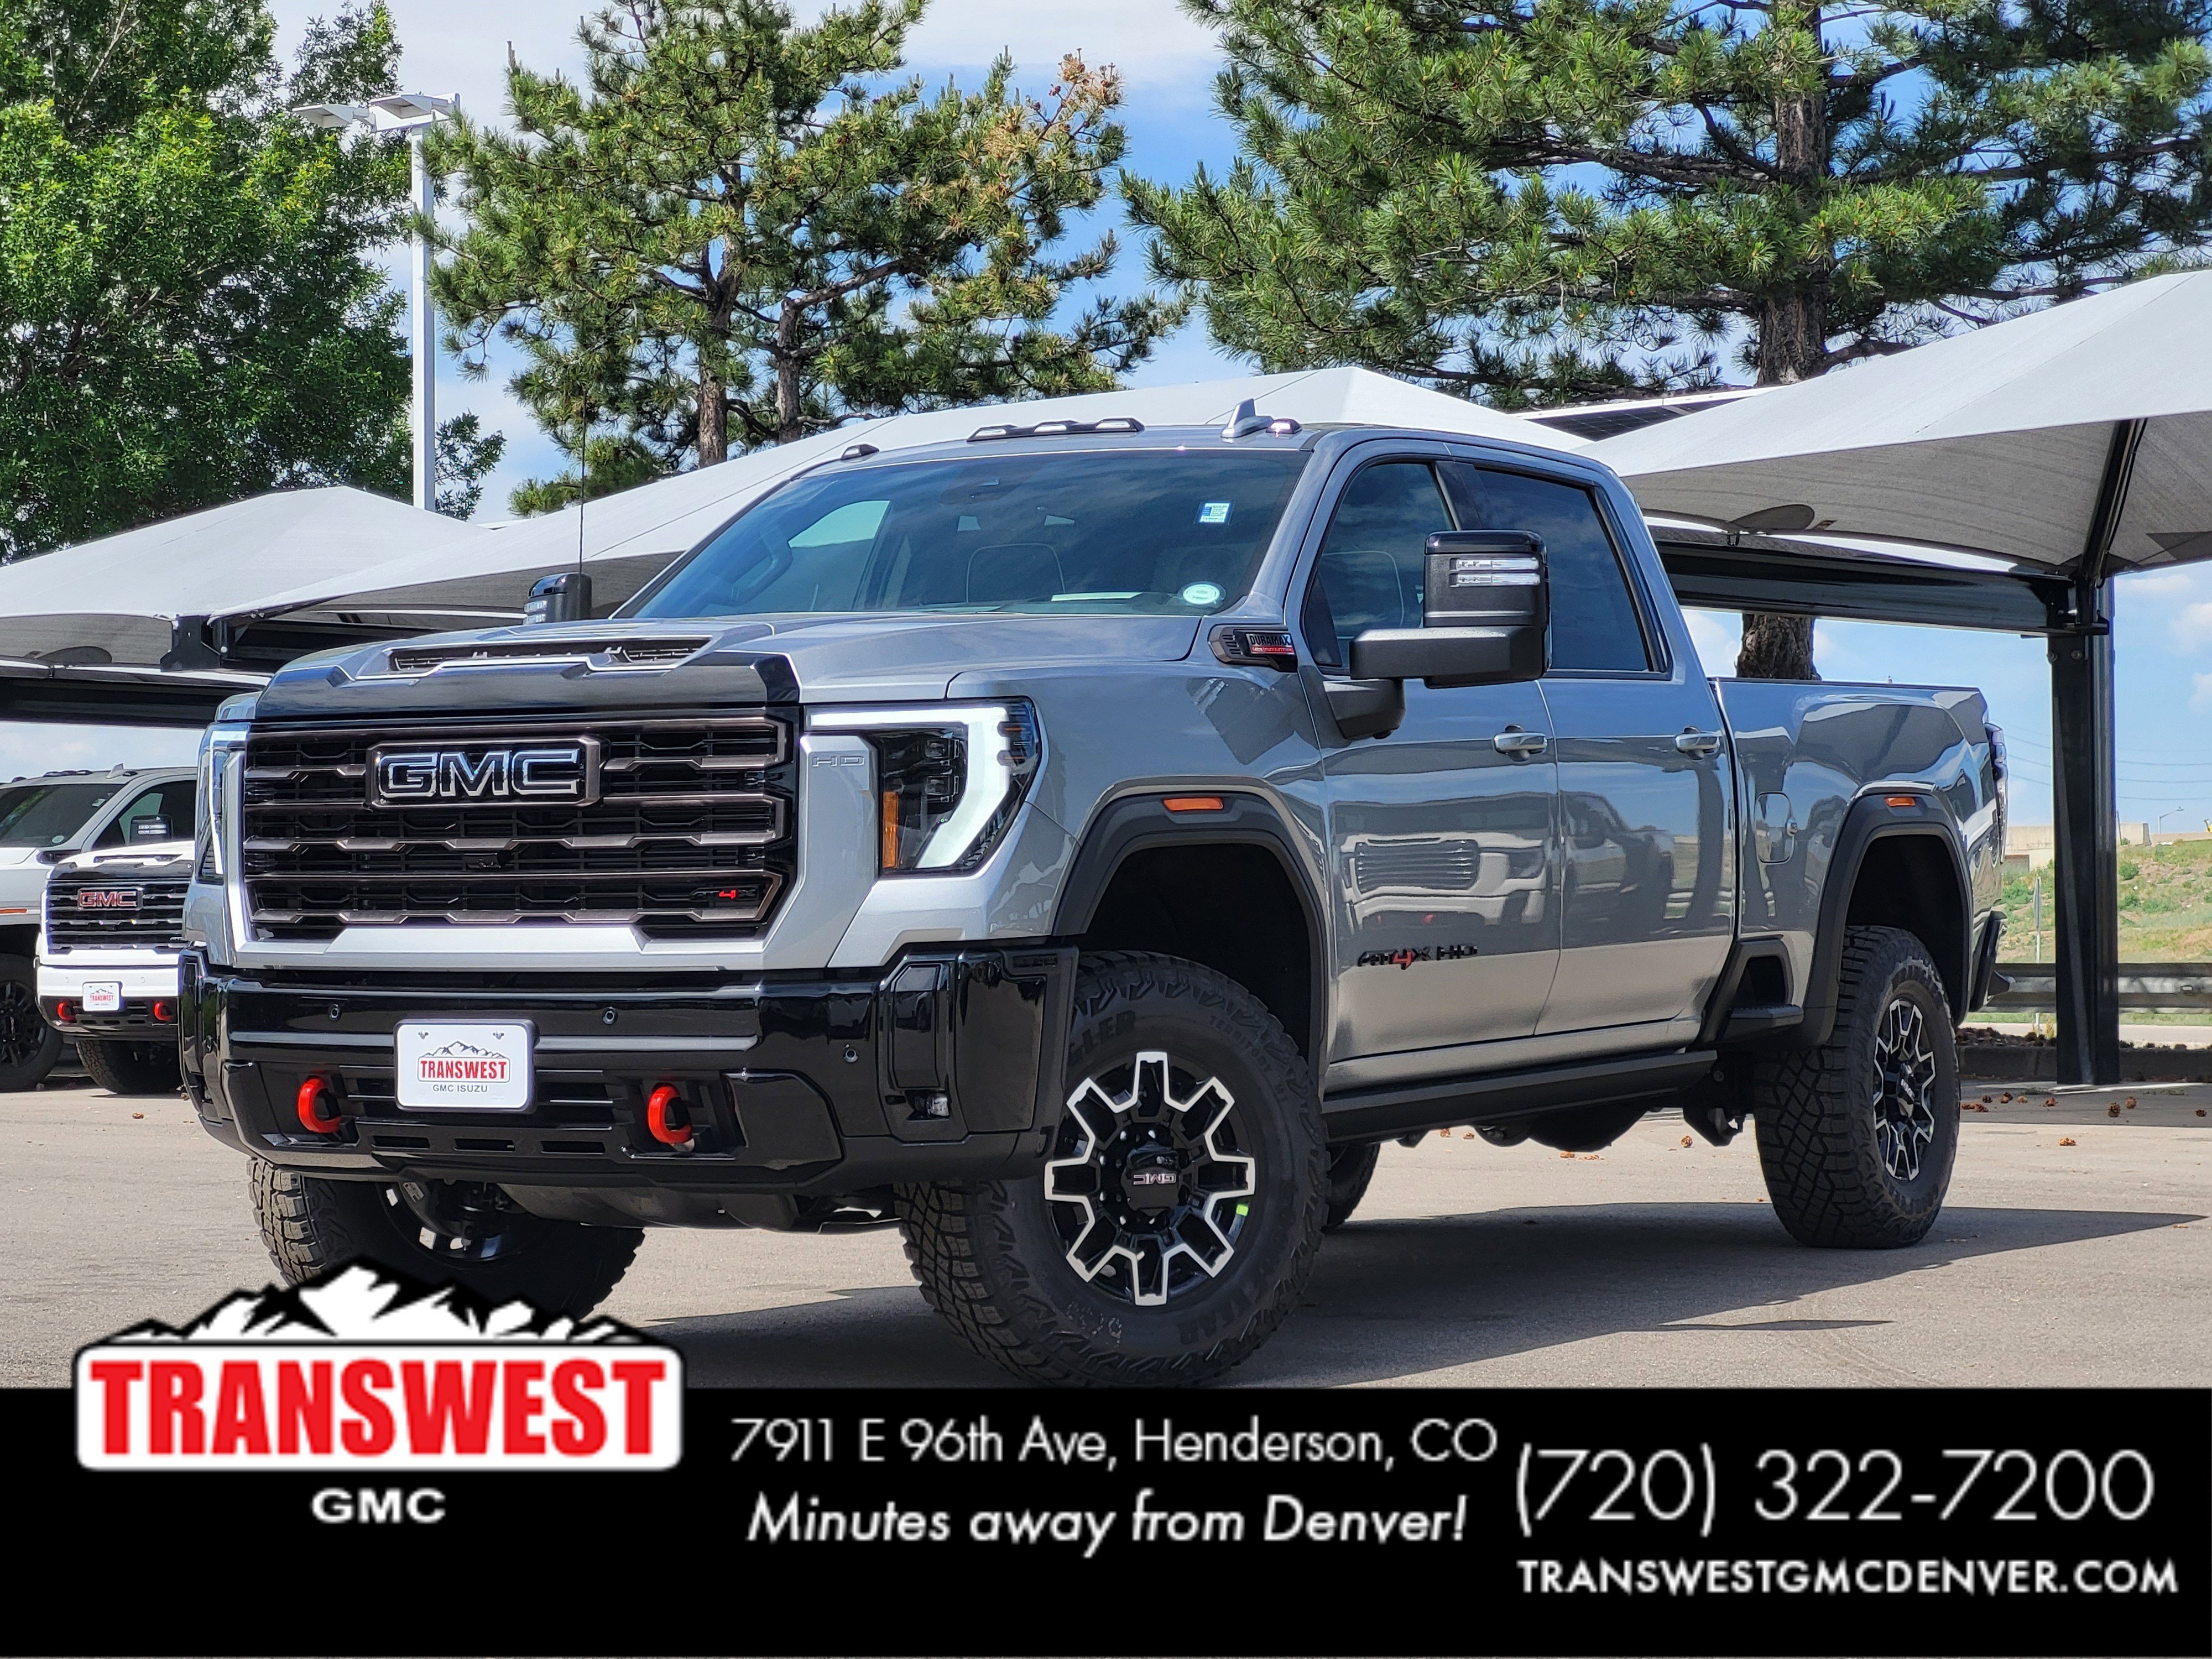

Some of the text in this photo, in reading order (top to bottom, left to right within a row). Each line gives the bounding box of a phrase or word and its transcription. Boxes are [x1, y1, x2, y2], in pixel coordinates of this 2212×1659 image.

[1249, 635, 1290, 646] DURAMAX
[812, 755, 864, 767] HD
[379, 748, 580, 797] GMC
[80, 891, 137, 907] GMC
[1357, 945, 1478, 970] AT4X HD
[1209, 1015, 1273, 1073] TERRITORY
[420, 1060, 507, 1079] TRANSWEST
[457, 1084, 488, 1093] ISUZU
[1133, 1173, 1176, 1185] GMC
